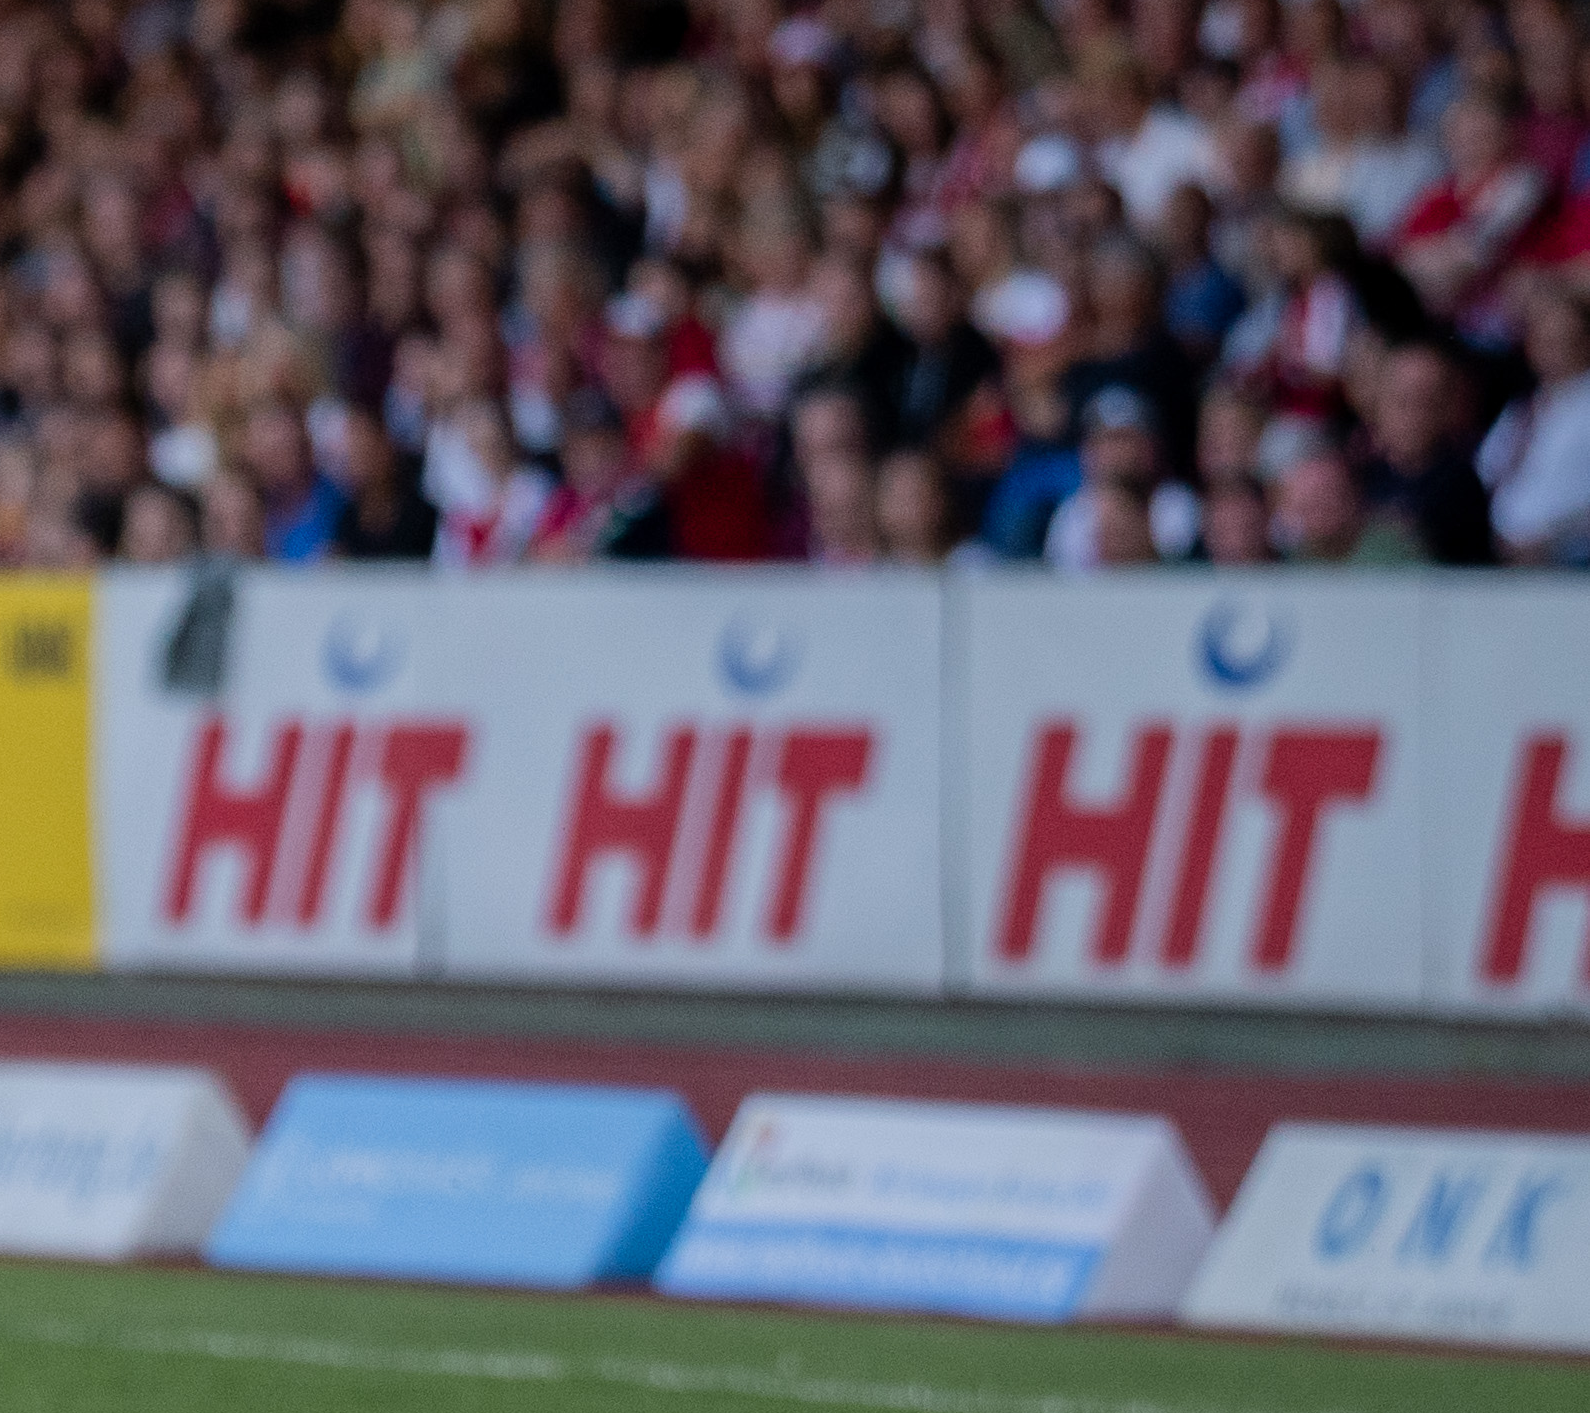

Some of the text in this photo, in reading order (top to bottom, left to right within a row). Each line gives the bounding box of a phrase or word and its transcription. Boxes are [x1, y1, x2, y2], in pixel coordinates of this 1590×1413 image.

[161, 713, 473, 932] HIT
[544, 719, 878, 946] HIT
[992, 715, 1388, 974] HIT
